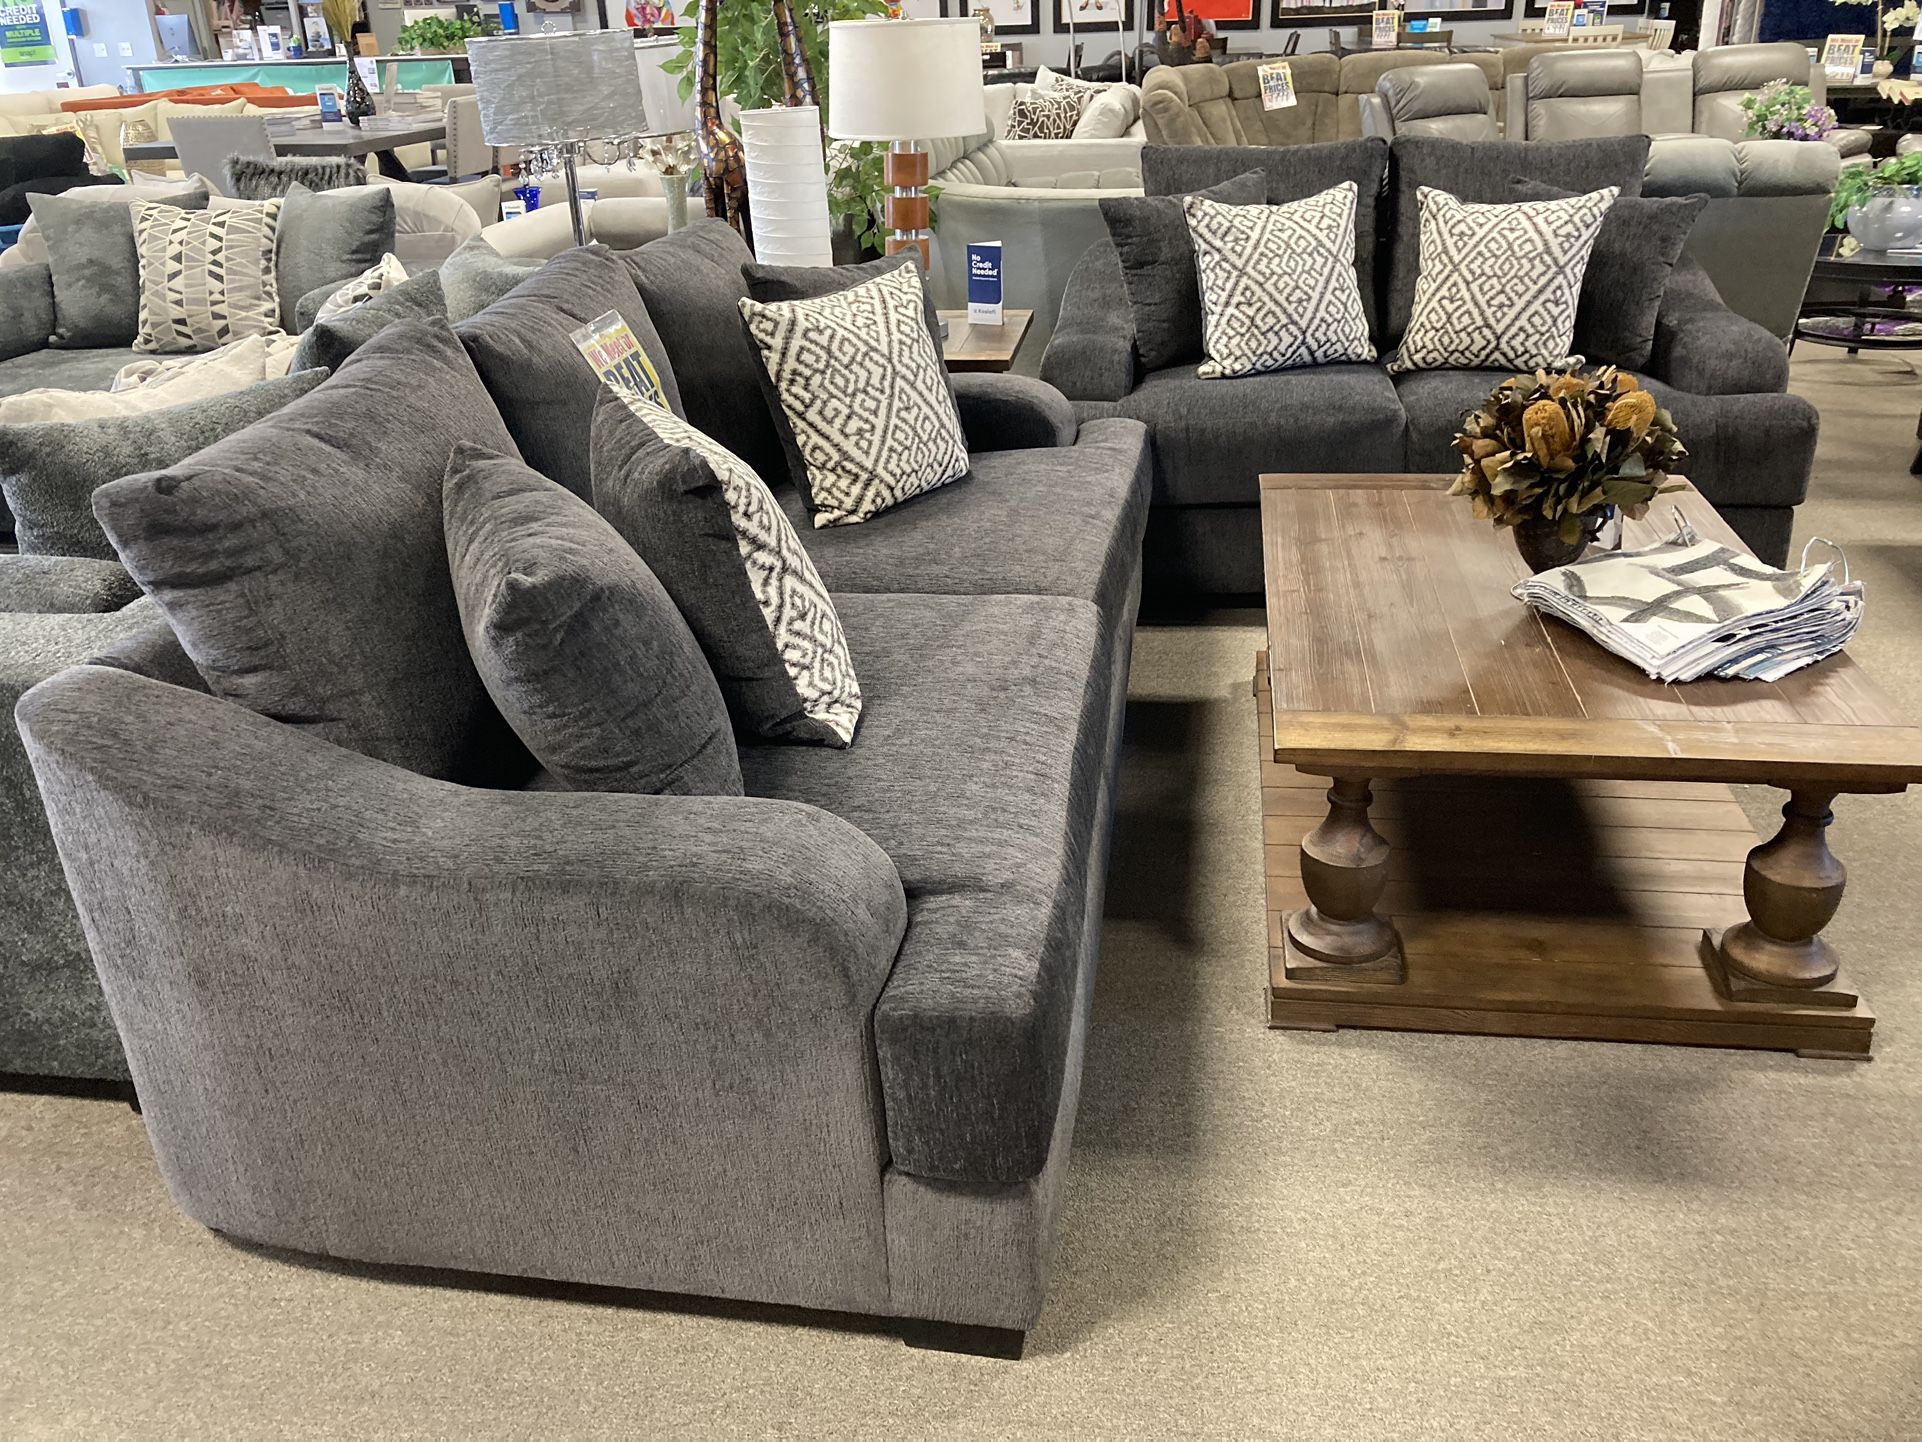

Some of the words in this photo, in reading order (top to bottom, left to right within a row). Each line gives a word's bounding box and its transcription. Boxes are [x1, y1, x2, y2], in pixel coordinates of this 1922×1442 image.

[0, 4, 37, 16] CREDIT
[0, 14, 40, 25] NEEDED
[1828, 44, 1858, 55] BEAT
[1262, 71, 1287, 85] BEAT
[1264, 81, 1290, 94] PRICES
